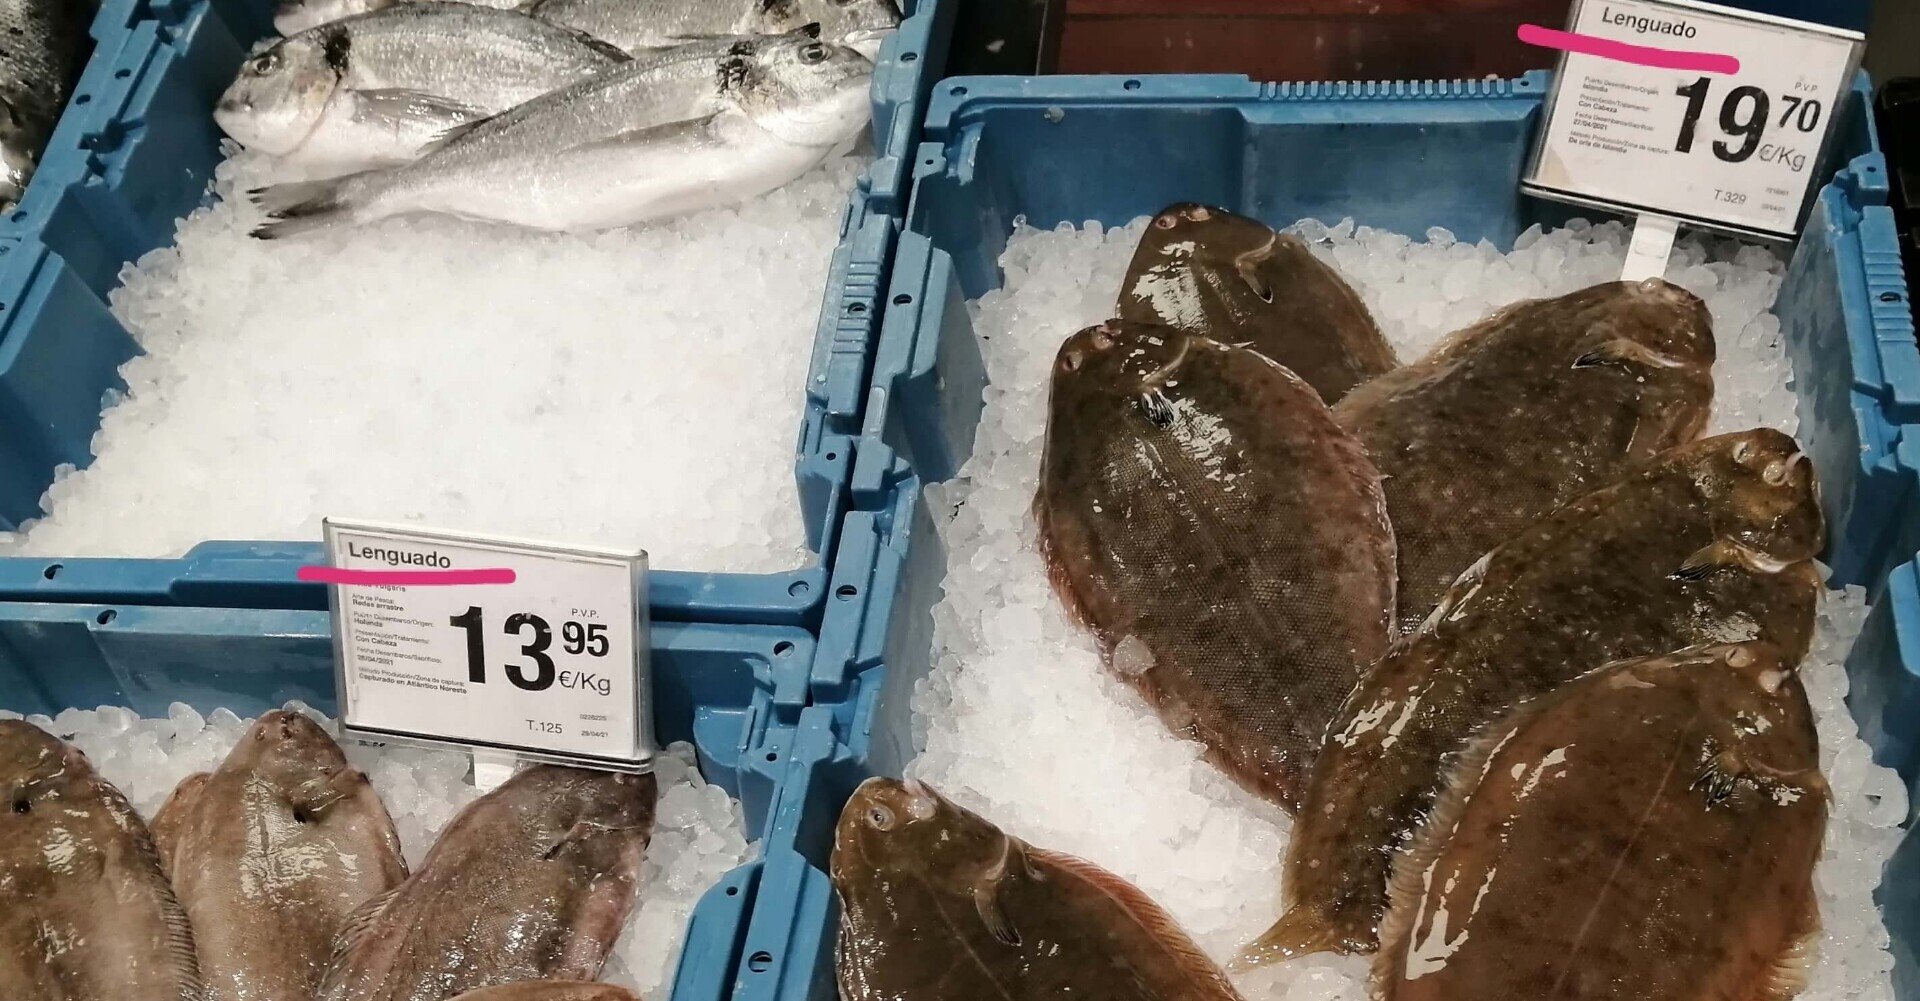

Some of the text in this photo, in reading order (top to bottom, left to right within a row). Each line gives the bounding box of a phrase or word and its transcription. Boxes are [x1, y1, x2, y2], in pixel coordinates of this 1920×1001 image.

[1602, 7, 1697, 39] Lenguado
[1578, 100, 1617, 113] Con Cabeza
[1675, 76, 1770, 163] 19
[1778, 94, 1822, 133] 70
[1758, 144, 1806, 172] €/Kg
[348, 542, 451, 568] Lenguado
[376, 602, 404, 611] arrastre
[571, 608, 600, 619] P.V.P.
[355, 635, 398, 647] Con Cabeza
[449, 606, 556, 692] 13
[562, 620, 610, 657] 95
[359, 672, 395, 685] Capturado
[439, 684, 467, 694] Noreste
[558, 670, 611, 696] €/Kg
[525, 719, 563, 734] T.125
